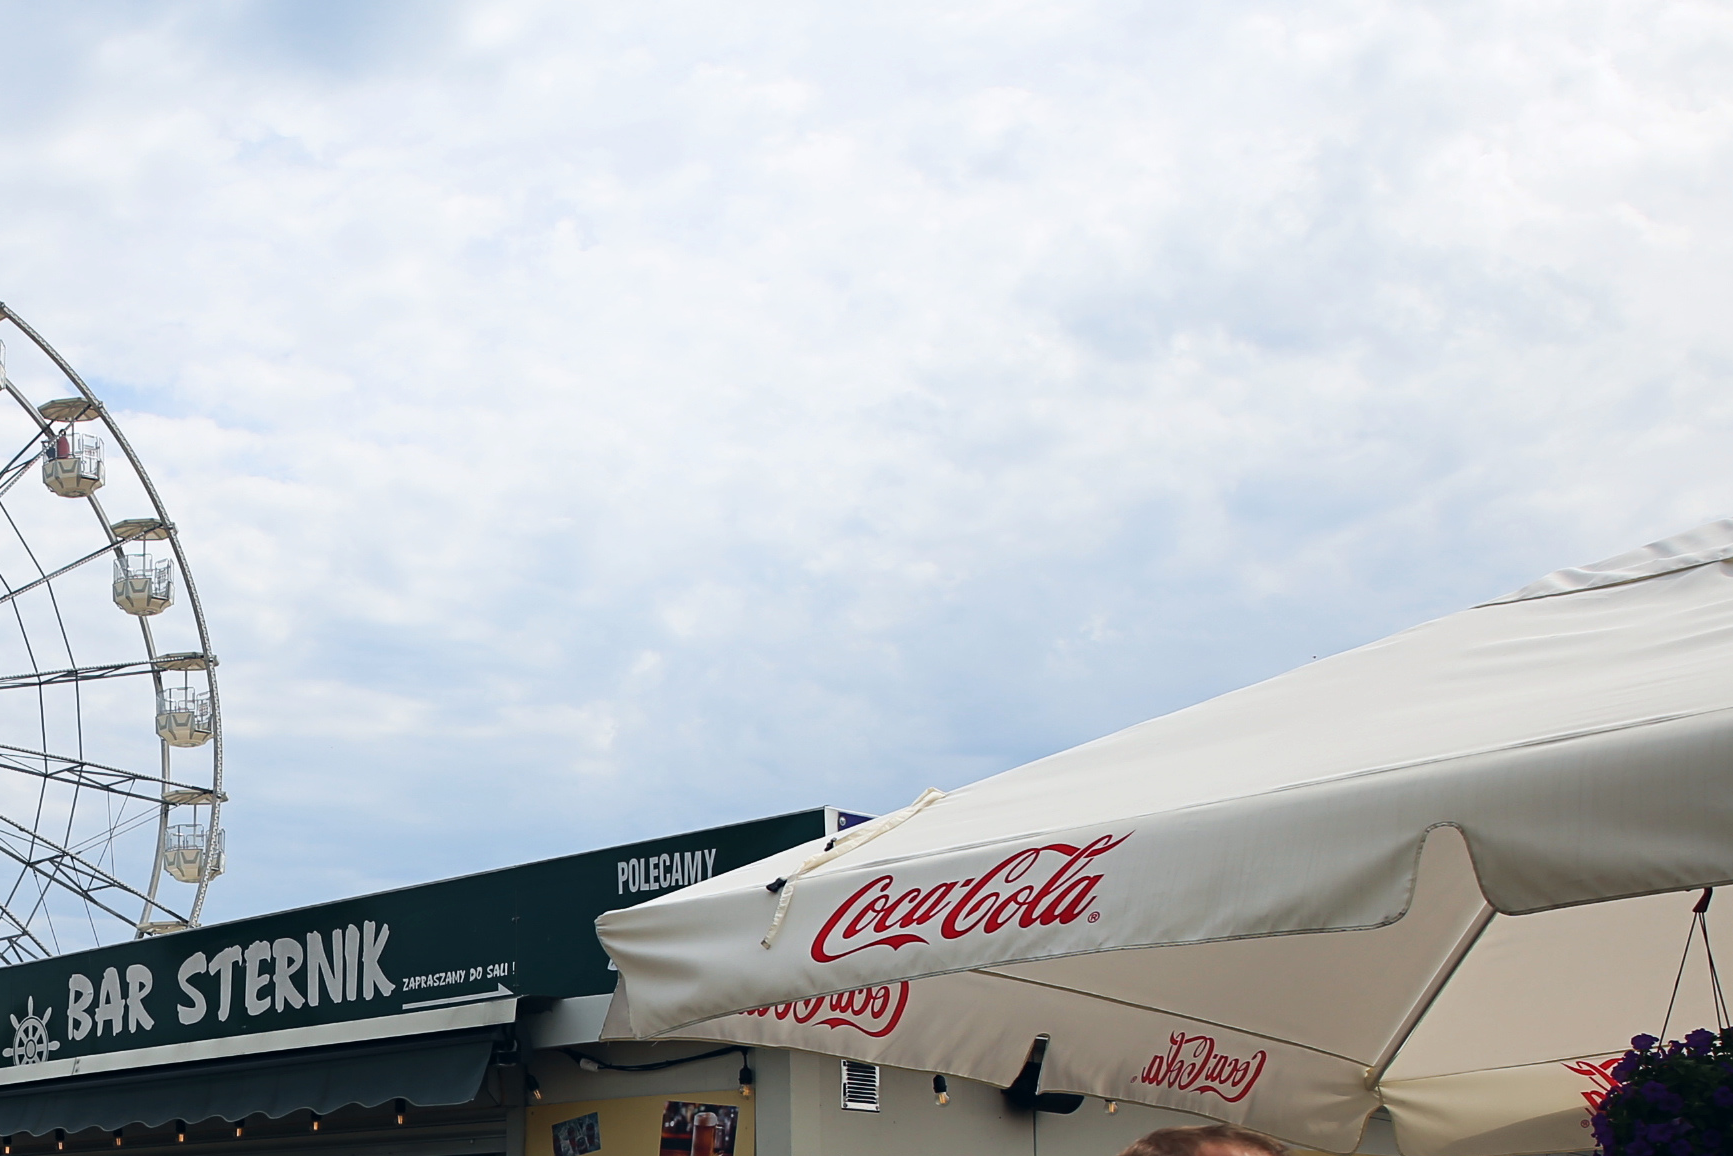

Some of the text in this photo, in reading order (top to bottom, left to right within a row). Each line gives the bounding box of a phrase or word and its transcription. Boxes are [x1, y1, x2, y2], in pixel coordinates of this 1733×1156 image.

[618, 849, 717, 895] POLECAMY
[810, 830, 1136, 964] Coca-Cola
[68, 919, 396, 1041] BAR STERNIK
[402, 969, 466, 991] ZAPRASZAMY
[469, 966, 483, 982] DO
[487, 963, 508, 979] SALI
